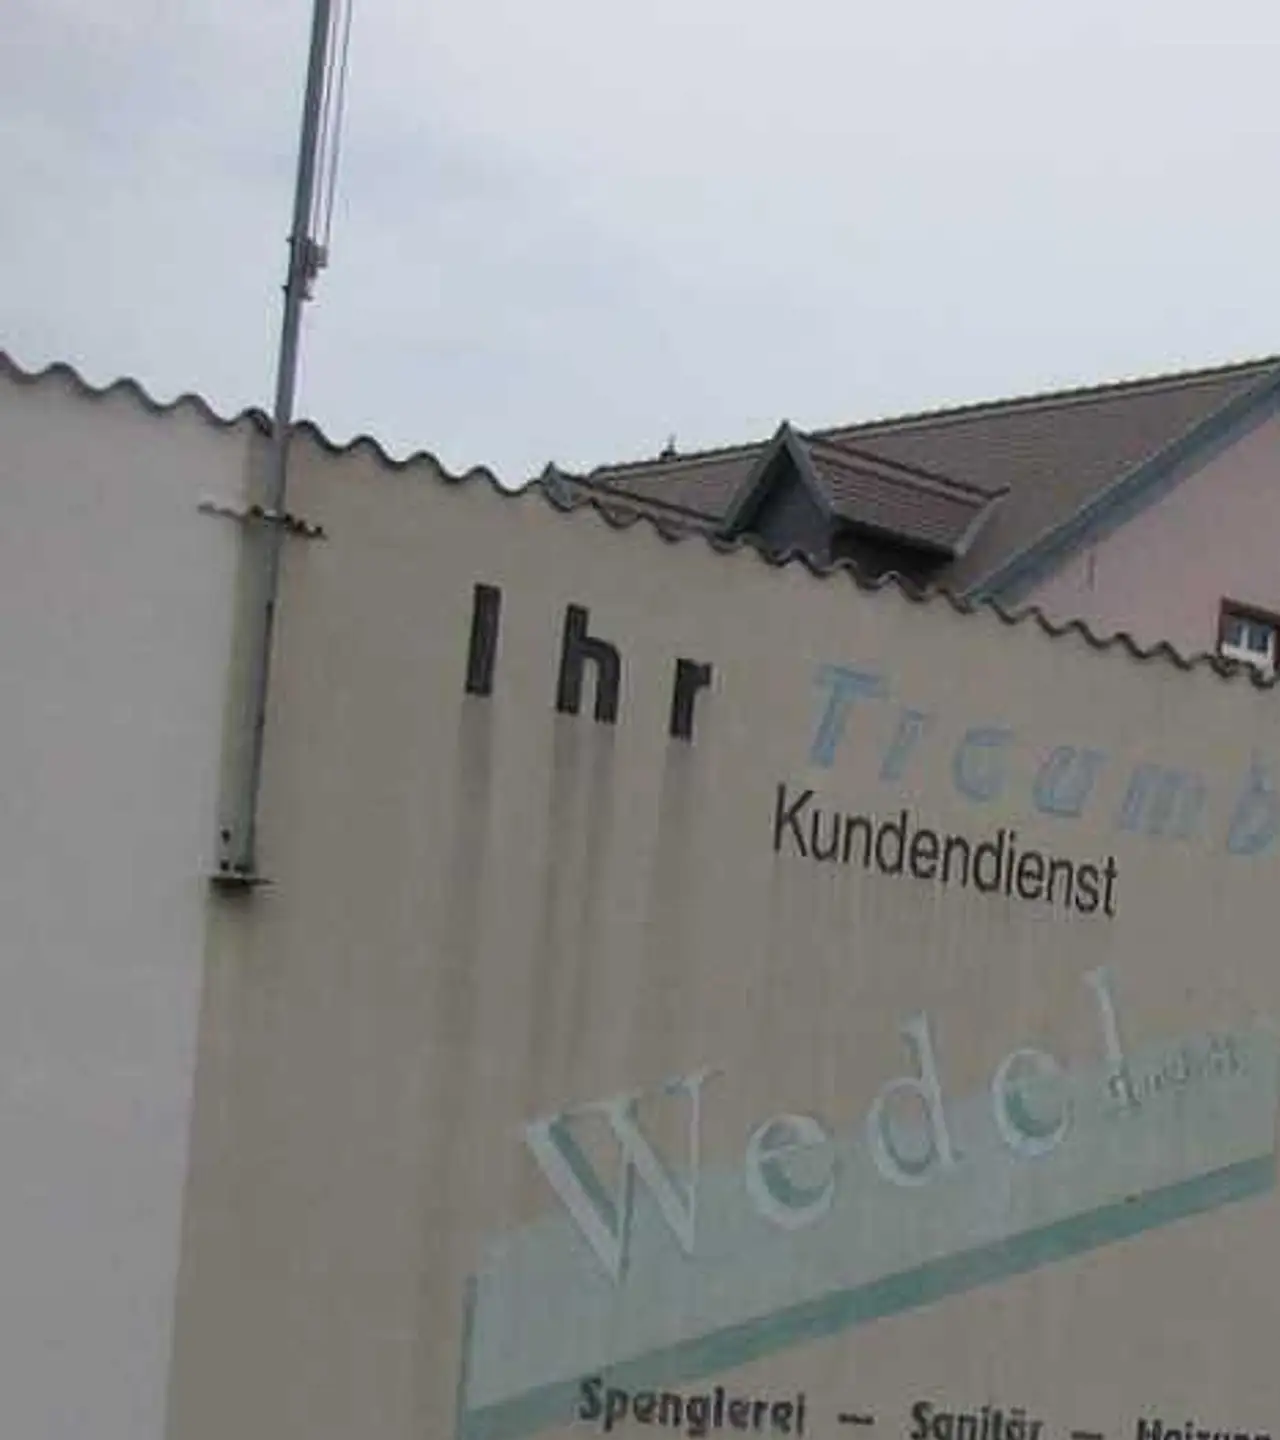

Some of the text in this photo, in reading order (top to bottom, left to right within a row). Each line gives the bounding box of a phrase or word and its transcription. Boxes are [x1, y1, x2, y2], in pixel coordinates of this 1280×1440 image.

[463, 583, 712, 742] Ihr
[773, 784, 1118, 916] Kundendienst
[525, 965, 1123, 1286] Wedel
[579, 1377, 805, 1437] Spenglerei
